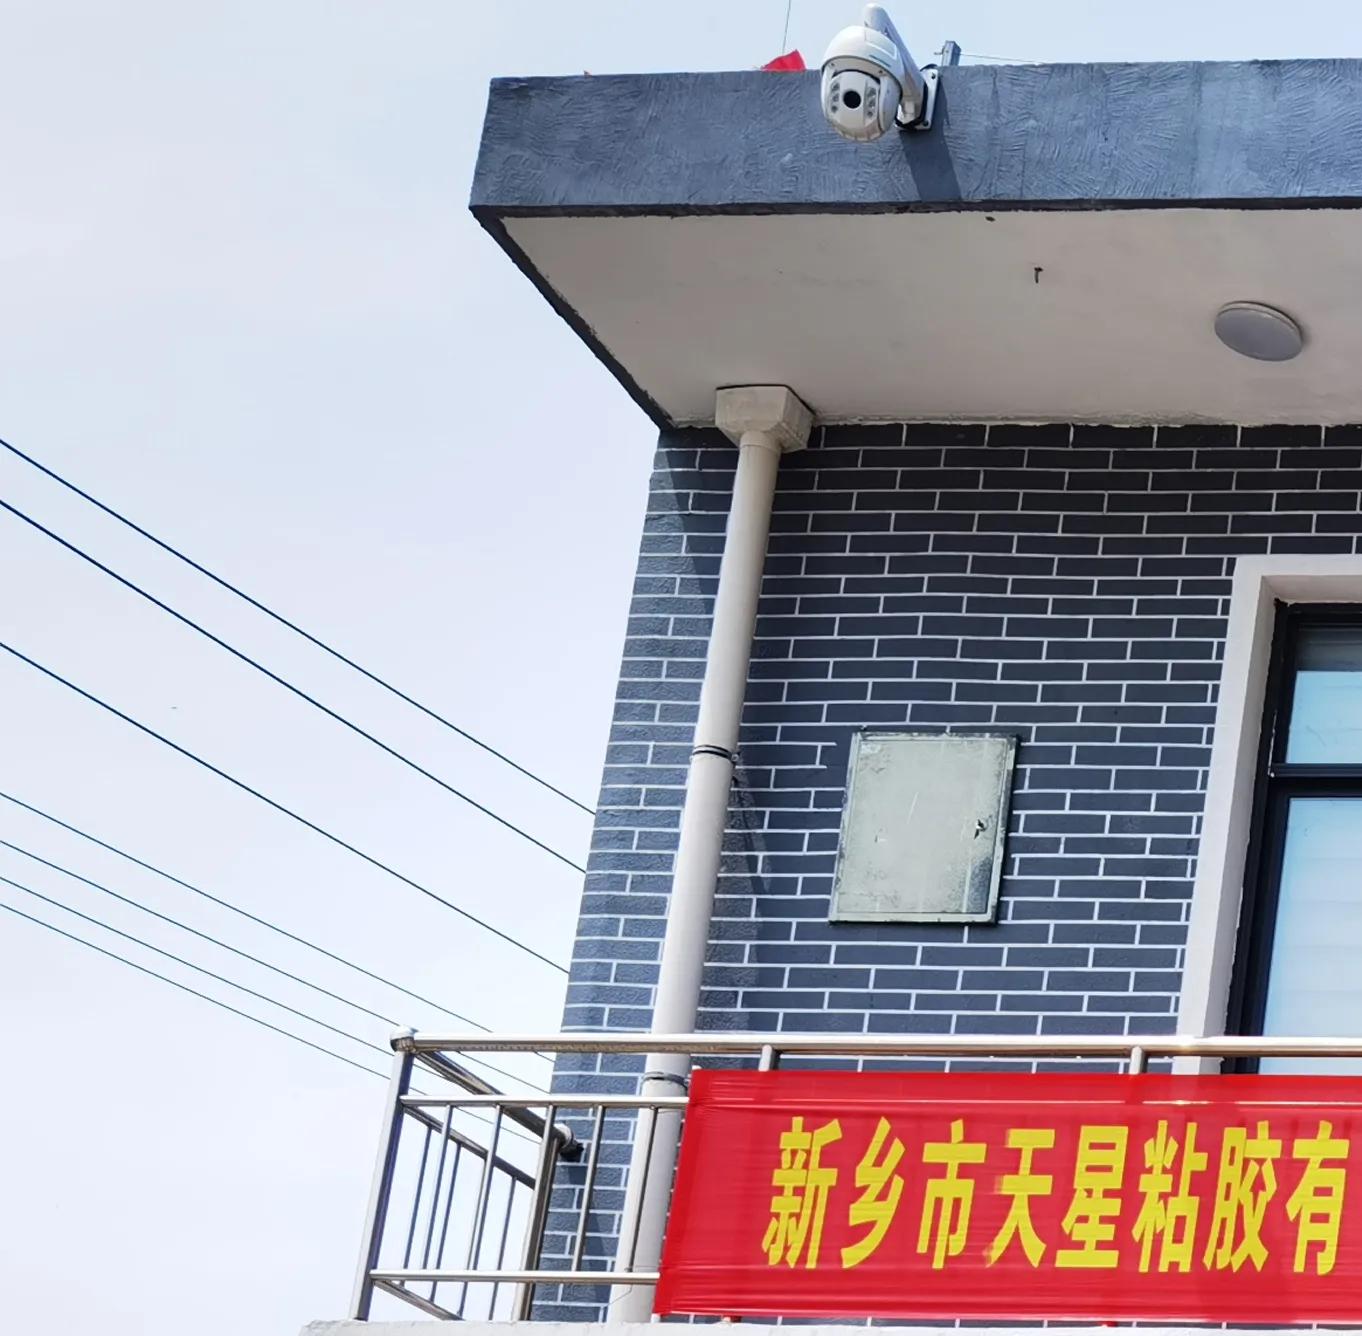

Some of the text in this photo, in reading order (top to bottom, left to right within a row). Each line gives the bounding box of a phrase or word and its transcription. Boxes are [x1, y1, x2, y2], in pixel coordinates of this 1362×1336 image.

[763, 1117, 1350, 1274] 新乡市天星粘胶有
